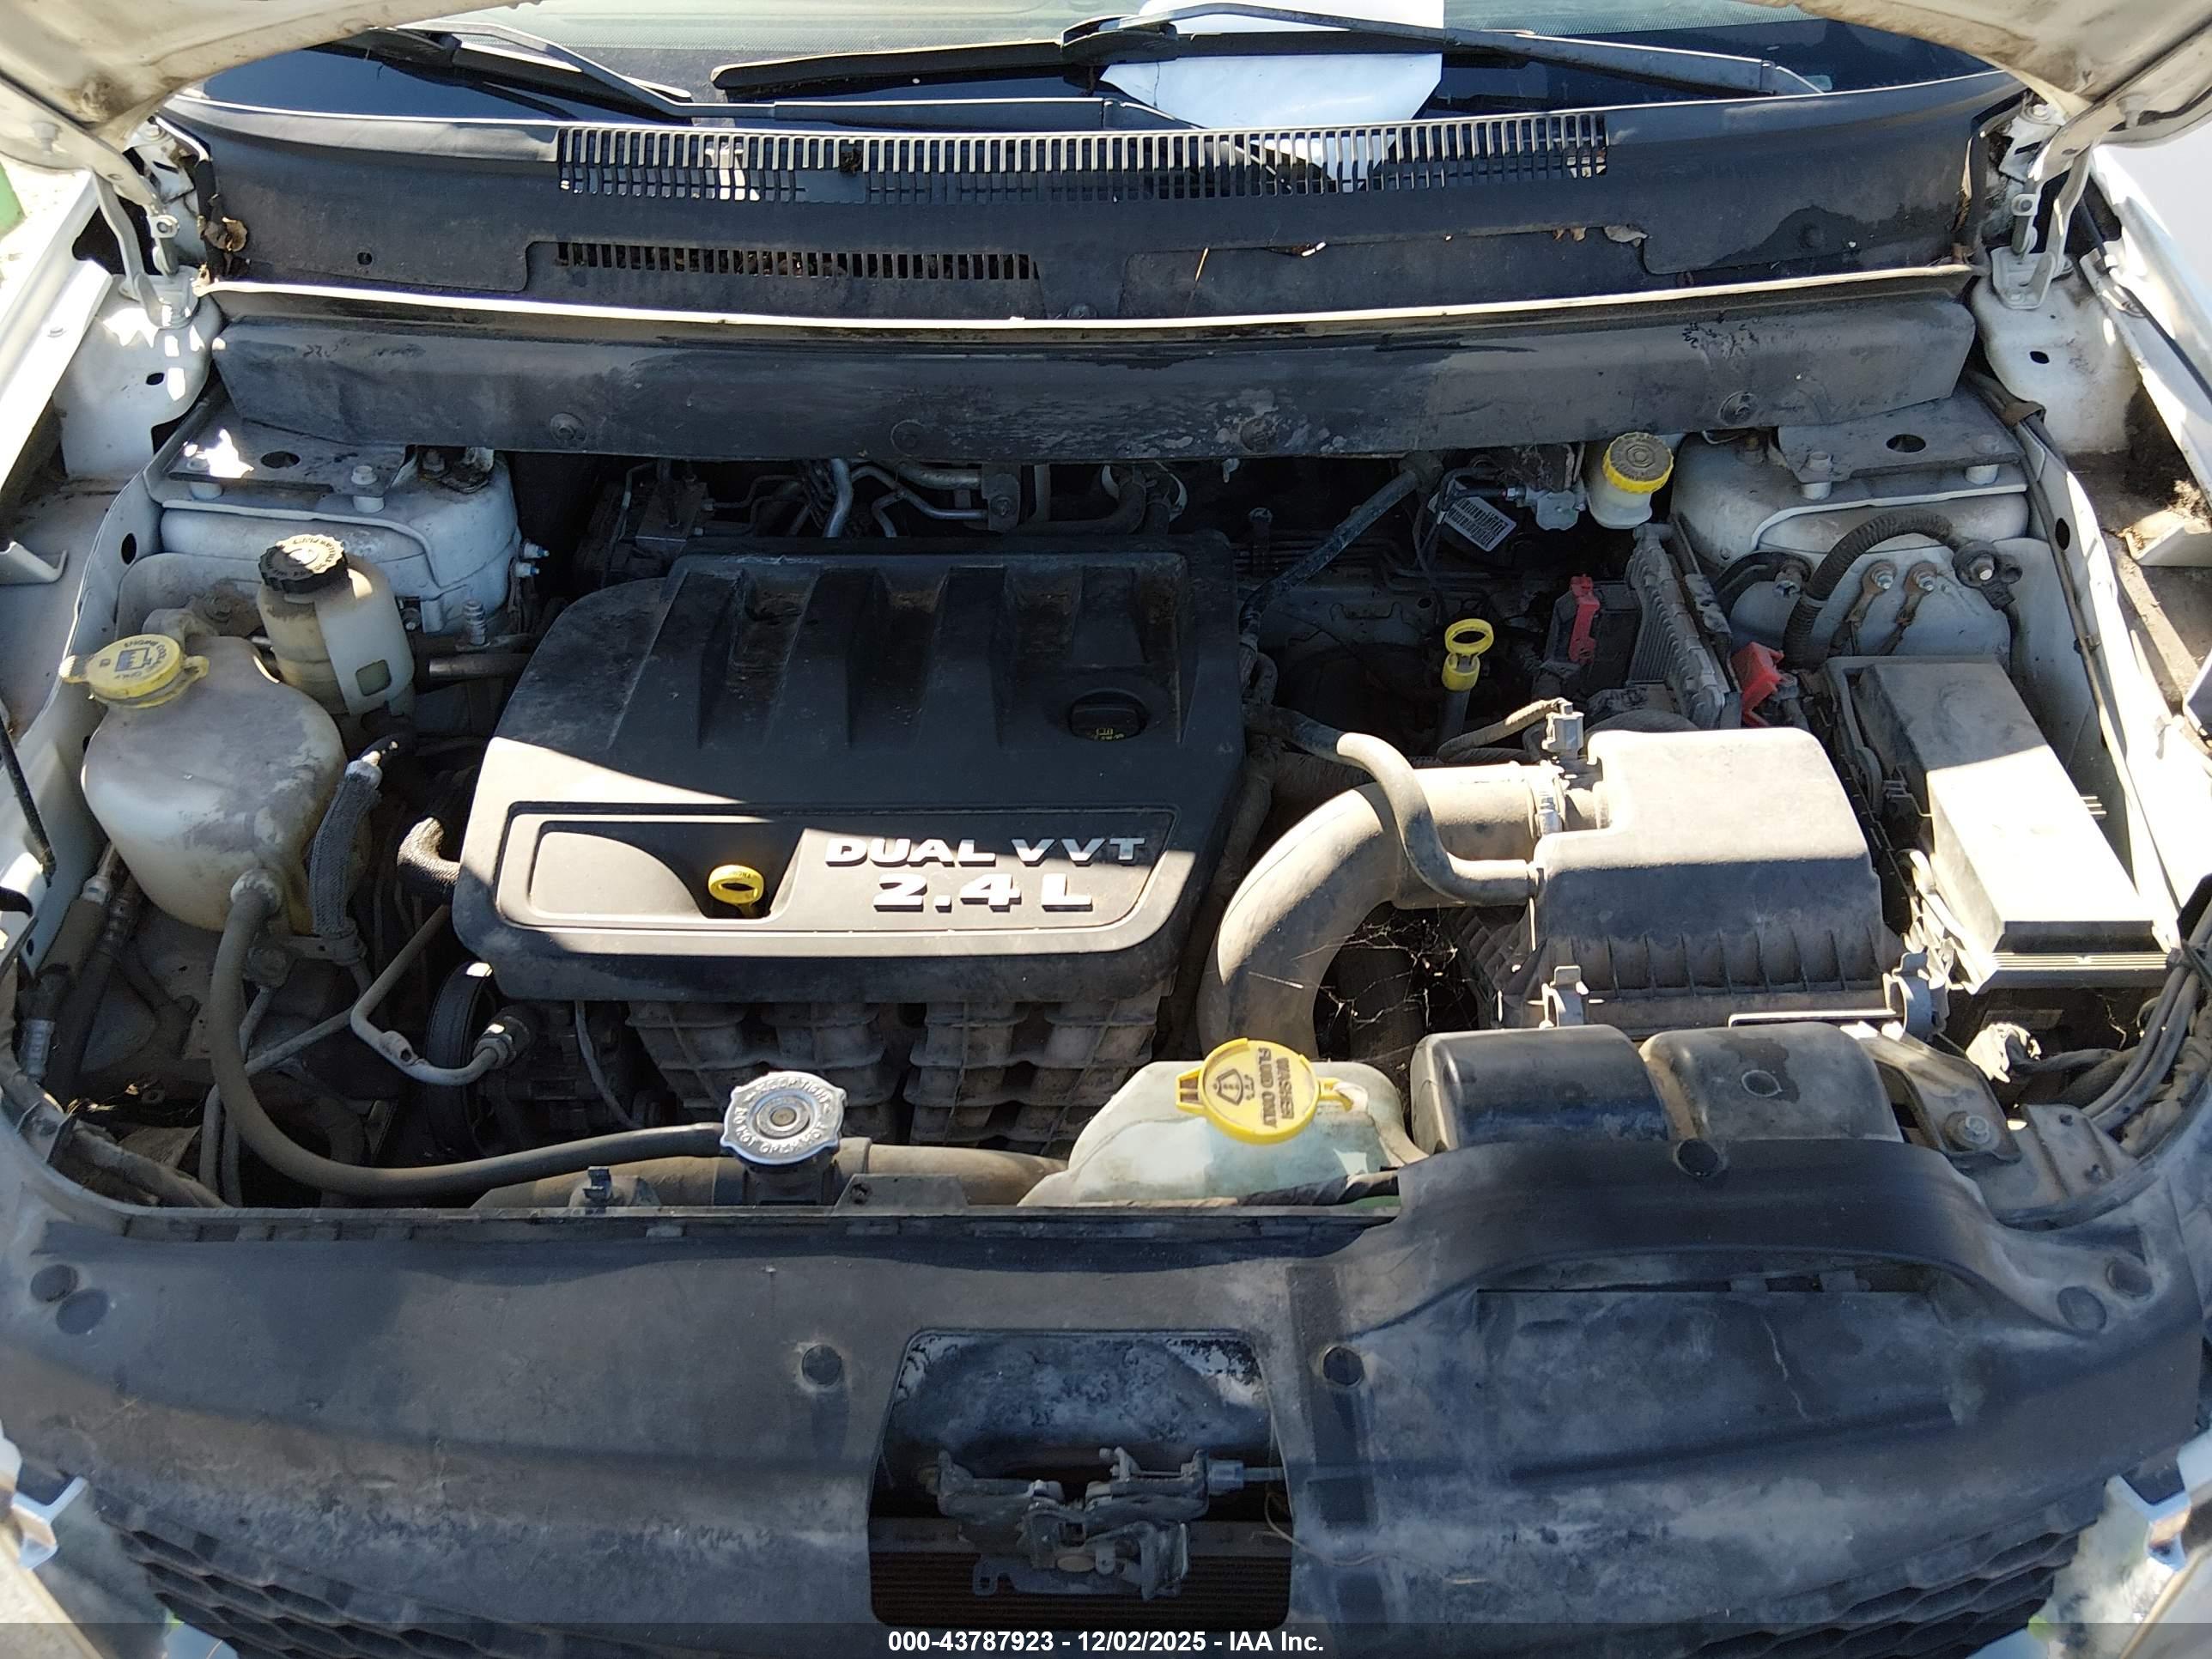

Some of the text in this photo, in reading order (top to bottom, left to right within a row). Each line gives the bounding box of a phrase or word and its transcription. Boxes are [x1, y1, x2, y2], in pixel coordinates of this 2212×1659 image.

[824, 837, 1147, 867] DUAL VVT
[800, 1077, 833, 1103] TIGHT
[1258, 1047, 1278, 1128] FLUID ONLY
[1276, 1057, 1294, 1120] WASHER
[733, 1106, 748, 1126] DO
[734, 1126, 757, 1147] NOT
